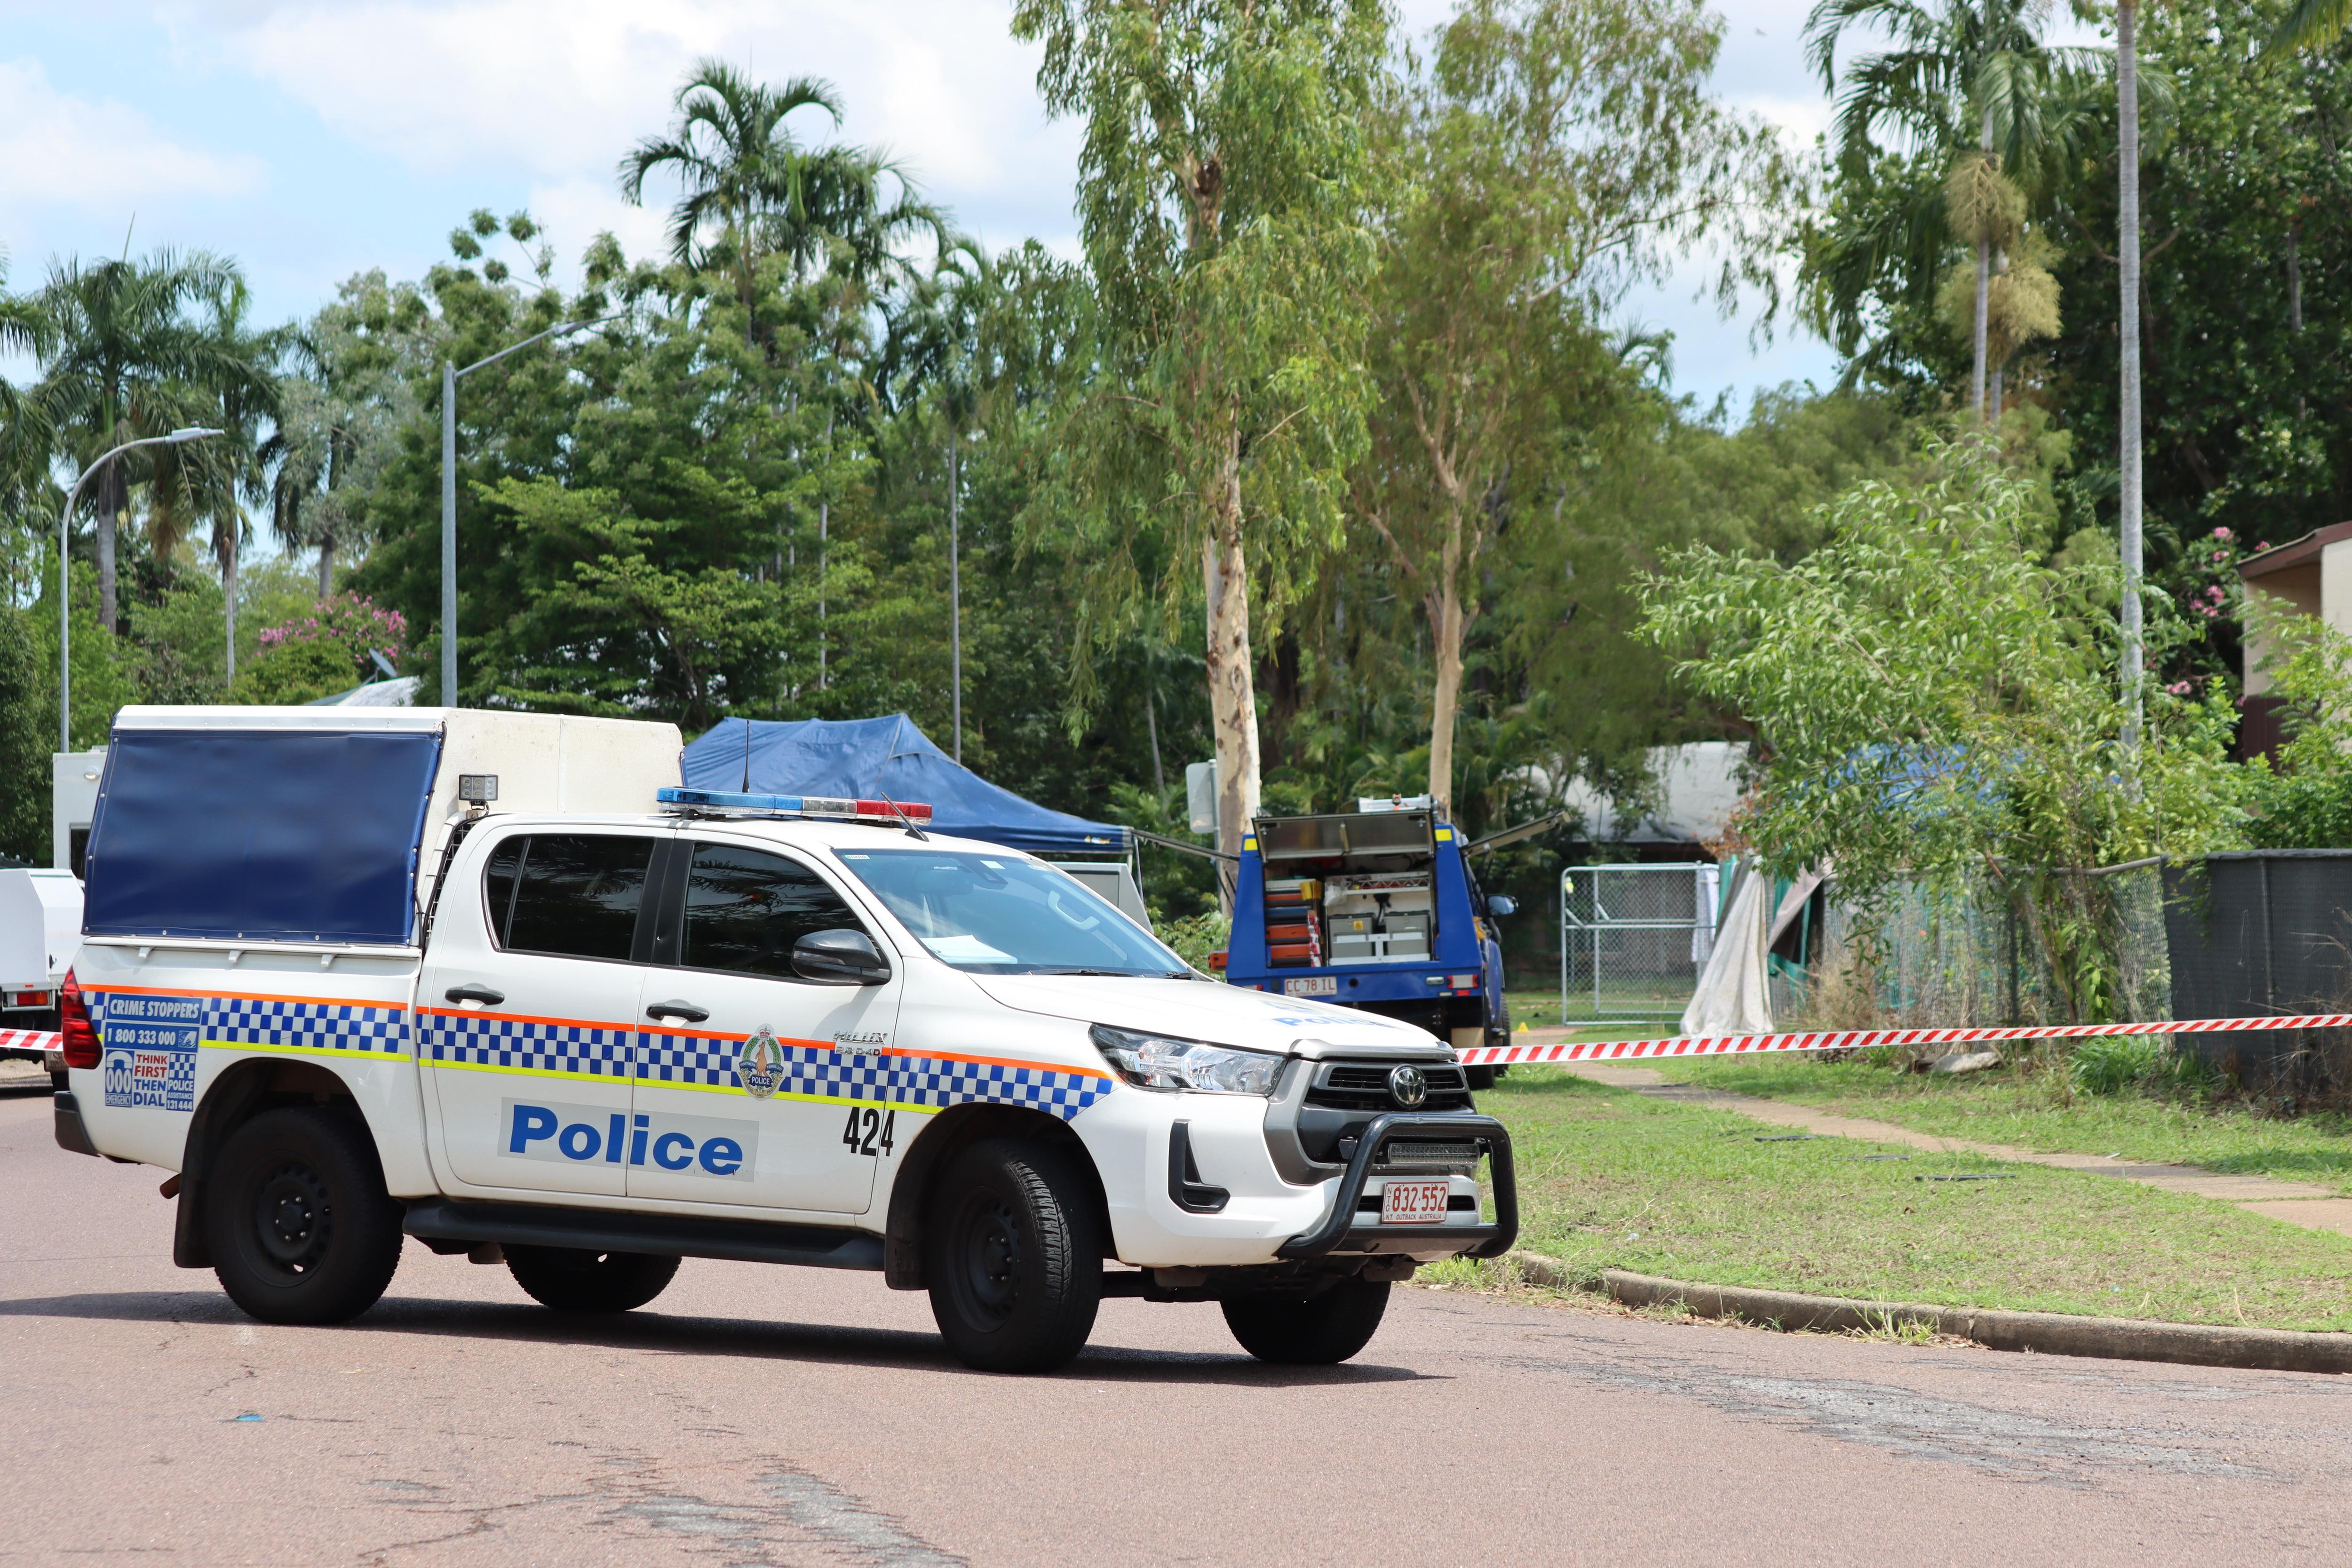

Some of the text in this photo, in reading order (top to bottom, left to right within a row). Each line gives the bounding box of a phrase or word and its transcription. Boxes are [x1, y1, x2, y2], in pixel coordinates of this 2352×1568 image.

[110, 999, 199, 1019] CRIME STOPPERS
[107, 1028, 176, 1046] 1 800 333 000
[833, 1030, 888, 1045] HILUX
[136, 1054, 167, 1065] THINK
[134, 1065, 167, 1078] FIRST
[106, 1068, 132, 1094] 000
[134, 1079, 166, 1091] THEN
[168, 1079, 193, 1091] POLICE
[752, 1076, 770, 1085] POLICE
[106, 1094, 131, 1105] EMERGENCY
[134, 1092, 165, 1107] DIAL
[843, 1106, 895, 1157] 424
[509, 1104, 743, 1175] Police
